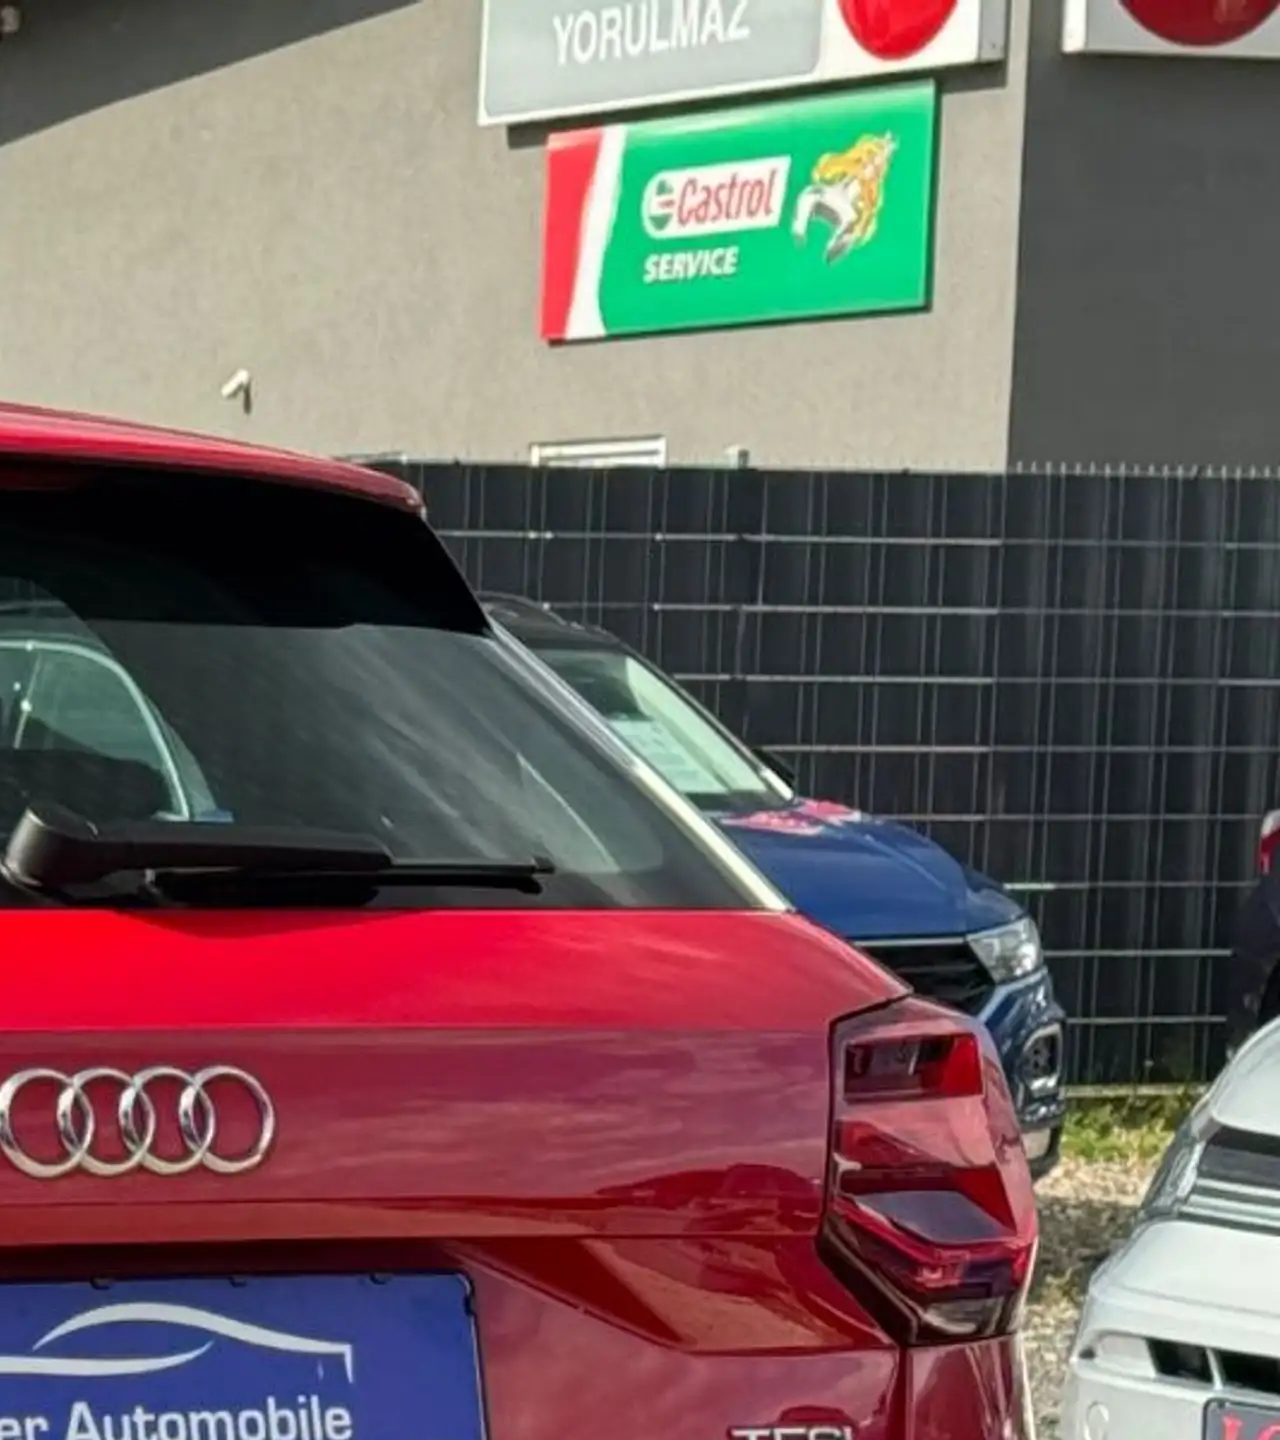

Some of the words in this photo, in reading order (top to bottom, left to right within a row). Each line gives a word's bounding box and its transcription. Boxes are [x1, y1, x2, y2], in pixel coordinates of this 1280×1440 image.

[552, 0, 751, 66] YORULMAZ
[677, 168, 778, 228] Castrol
[642, 245, 740, 285] SERVICE
